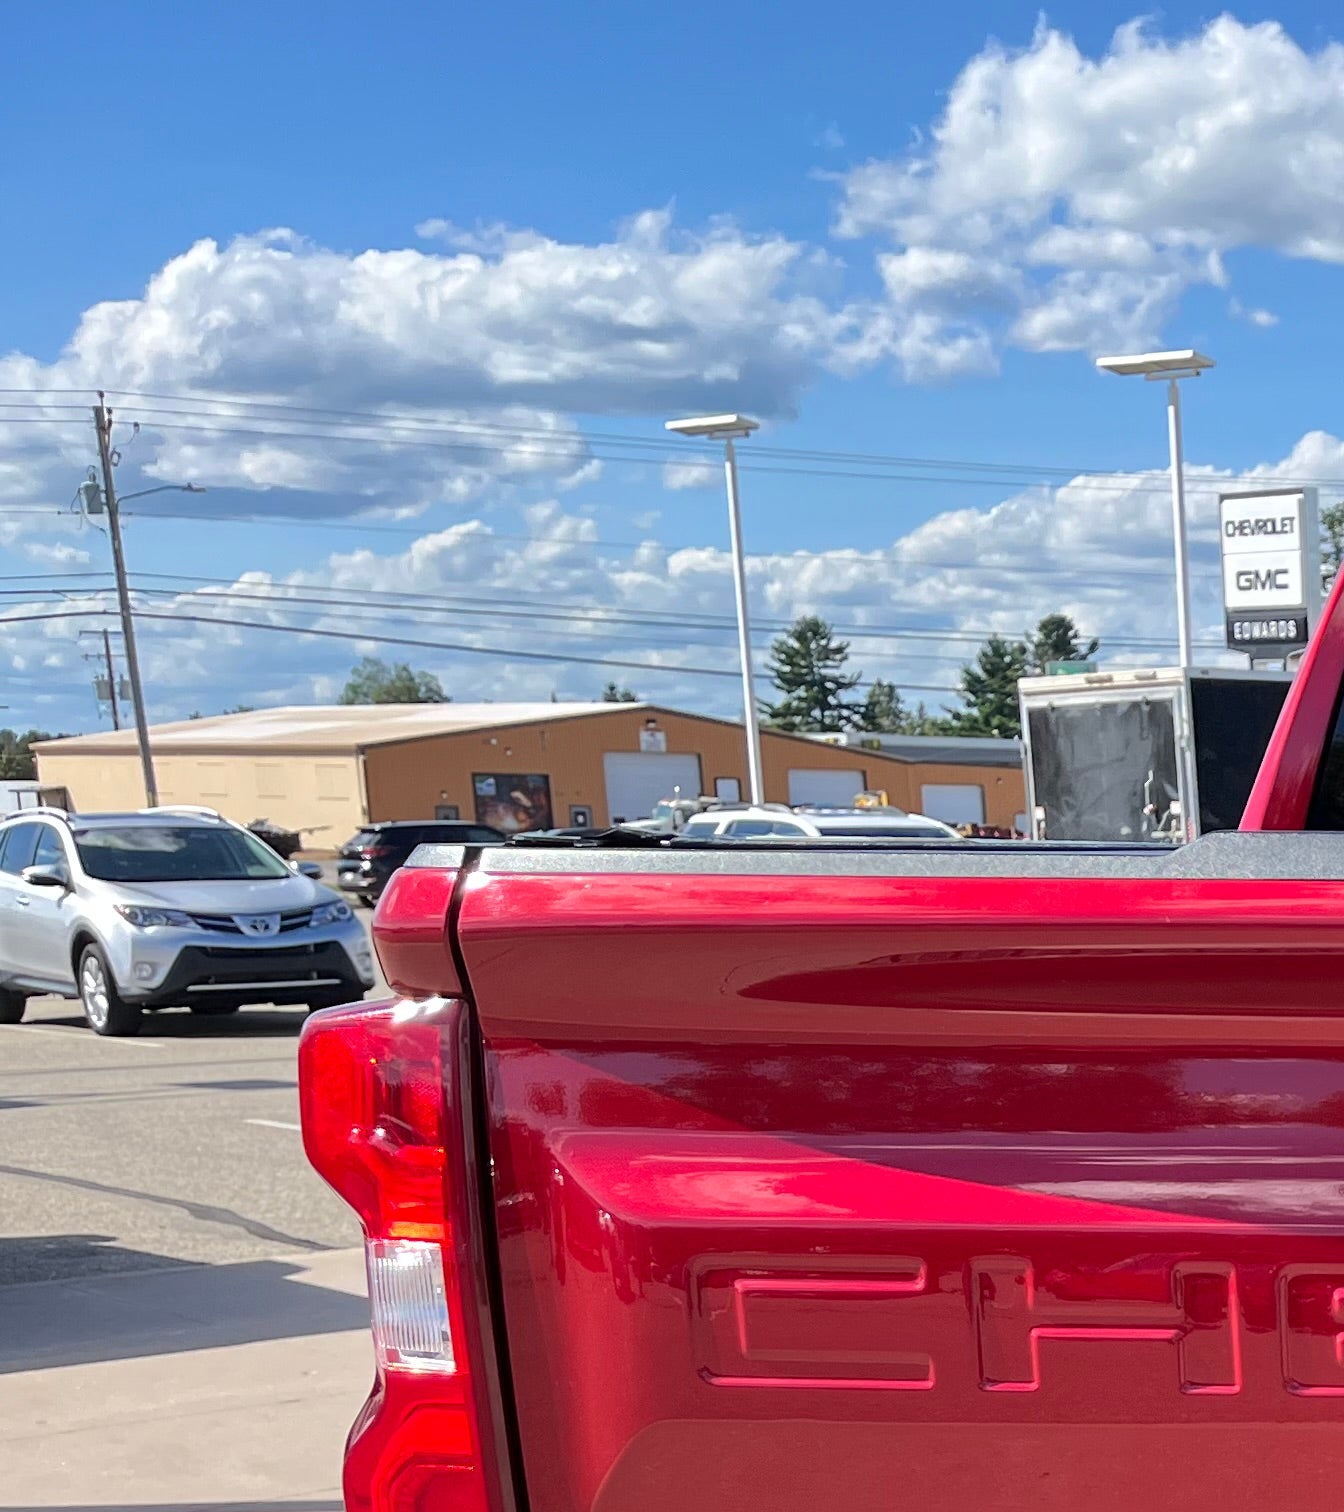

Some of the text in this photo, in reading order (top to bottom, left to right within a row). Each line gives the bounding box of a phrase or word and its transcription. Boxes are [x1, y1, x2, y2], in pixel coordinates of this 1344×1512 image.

[1225, 517, 1295, 537] CHEVROLET
[1236, 568, 1289, 591] GMC
[1233, 619, 1297, 640] EDWARDS
